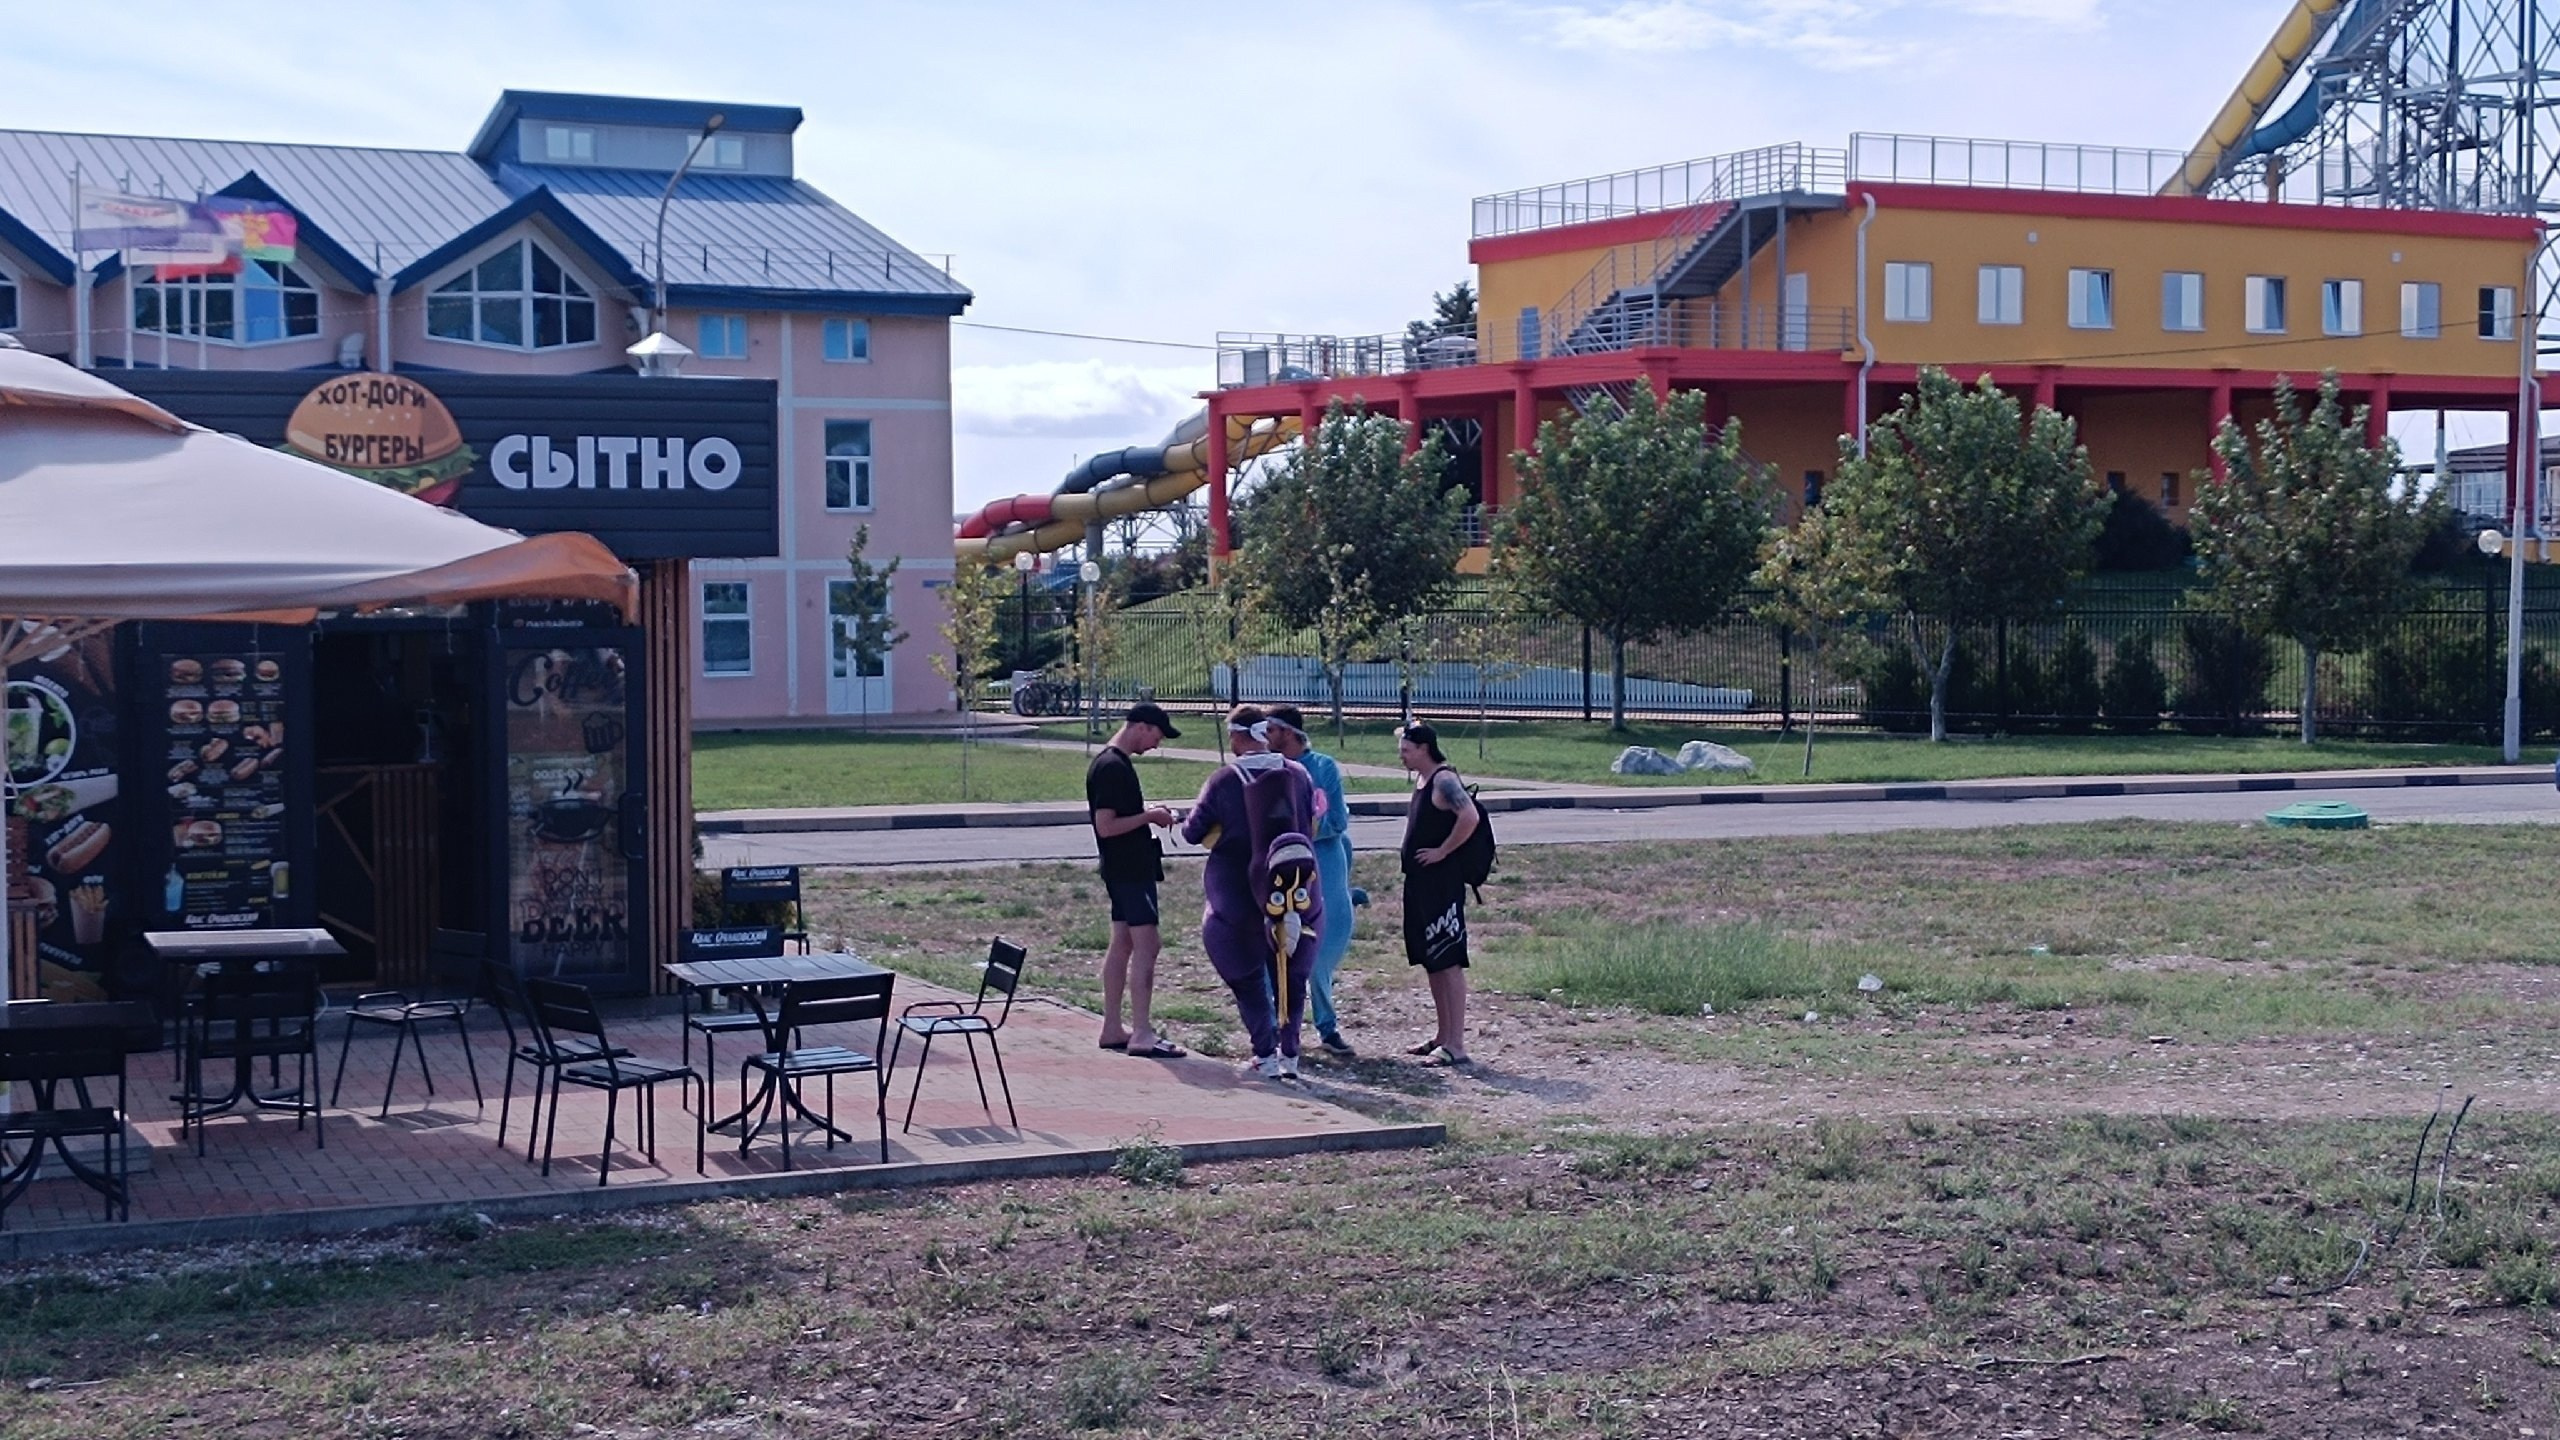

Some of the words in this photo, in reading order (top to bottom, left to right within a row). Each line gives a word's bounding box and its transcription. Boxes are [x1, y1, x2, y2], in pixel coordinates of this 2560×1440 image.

[318, 380, 426, 408] ХОТ-ДОГИ
[325, 433, 424, 464] БУРГЕРЫ
[490, 434, 742, 490] СЫТНО
[520, 899, 627, 943] BEER
